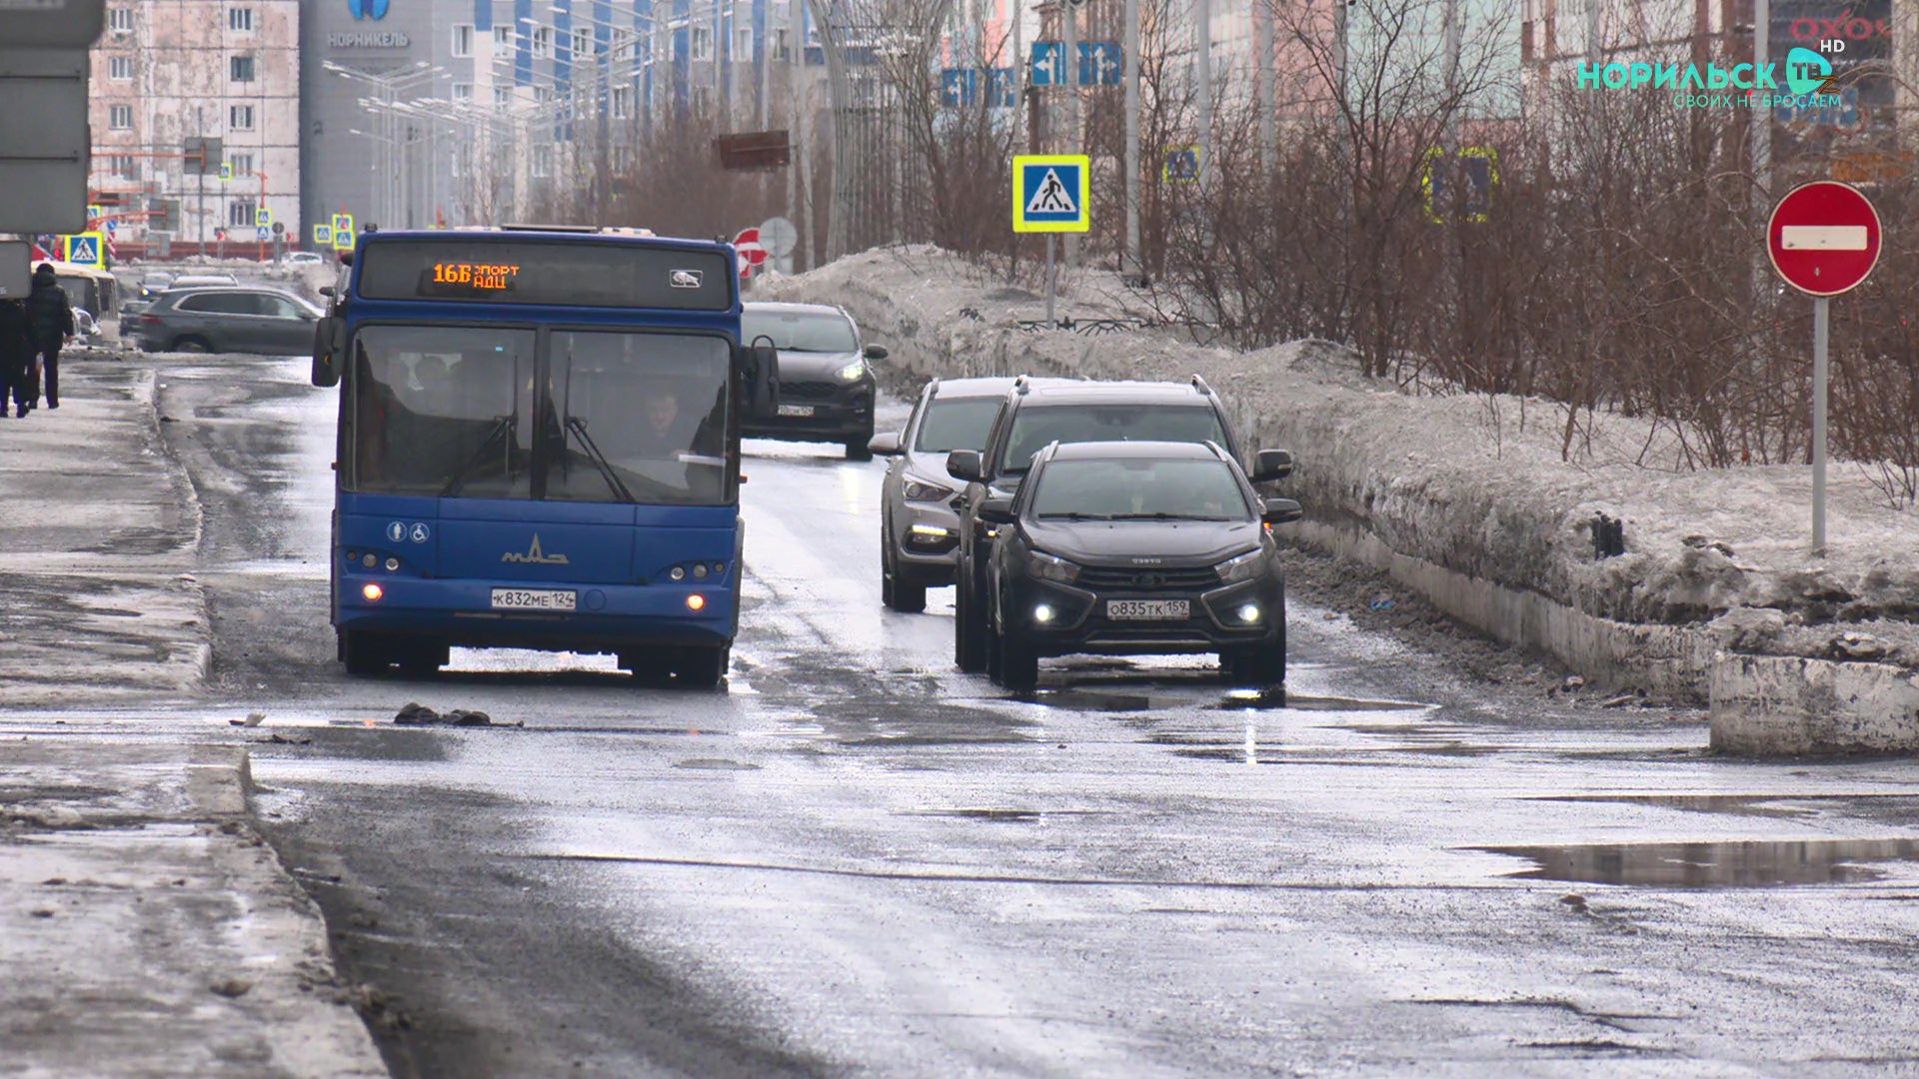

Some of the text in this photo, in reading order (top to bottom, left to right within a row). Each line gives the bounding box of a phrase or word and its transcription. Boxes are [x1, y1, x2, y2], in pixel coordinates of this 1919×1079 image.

[327, 32, 409, 48] НОРНИКЕЛЬ
[496, 591, 549, 607] К832МЕ
[1110, 600, 1187, 616] О835ТК 159
